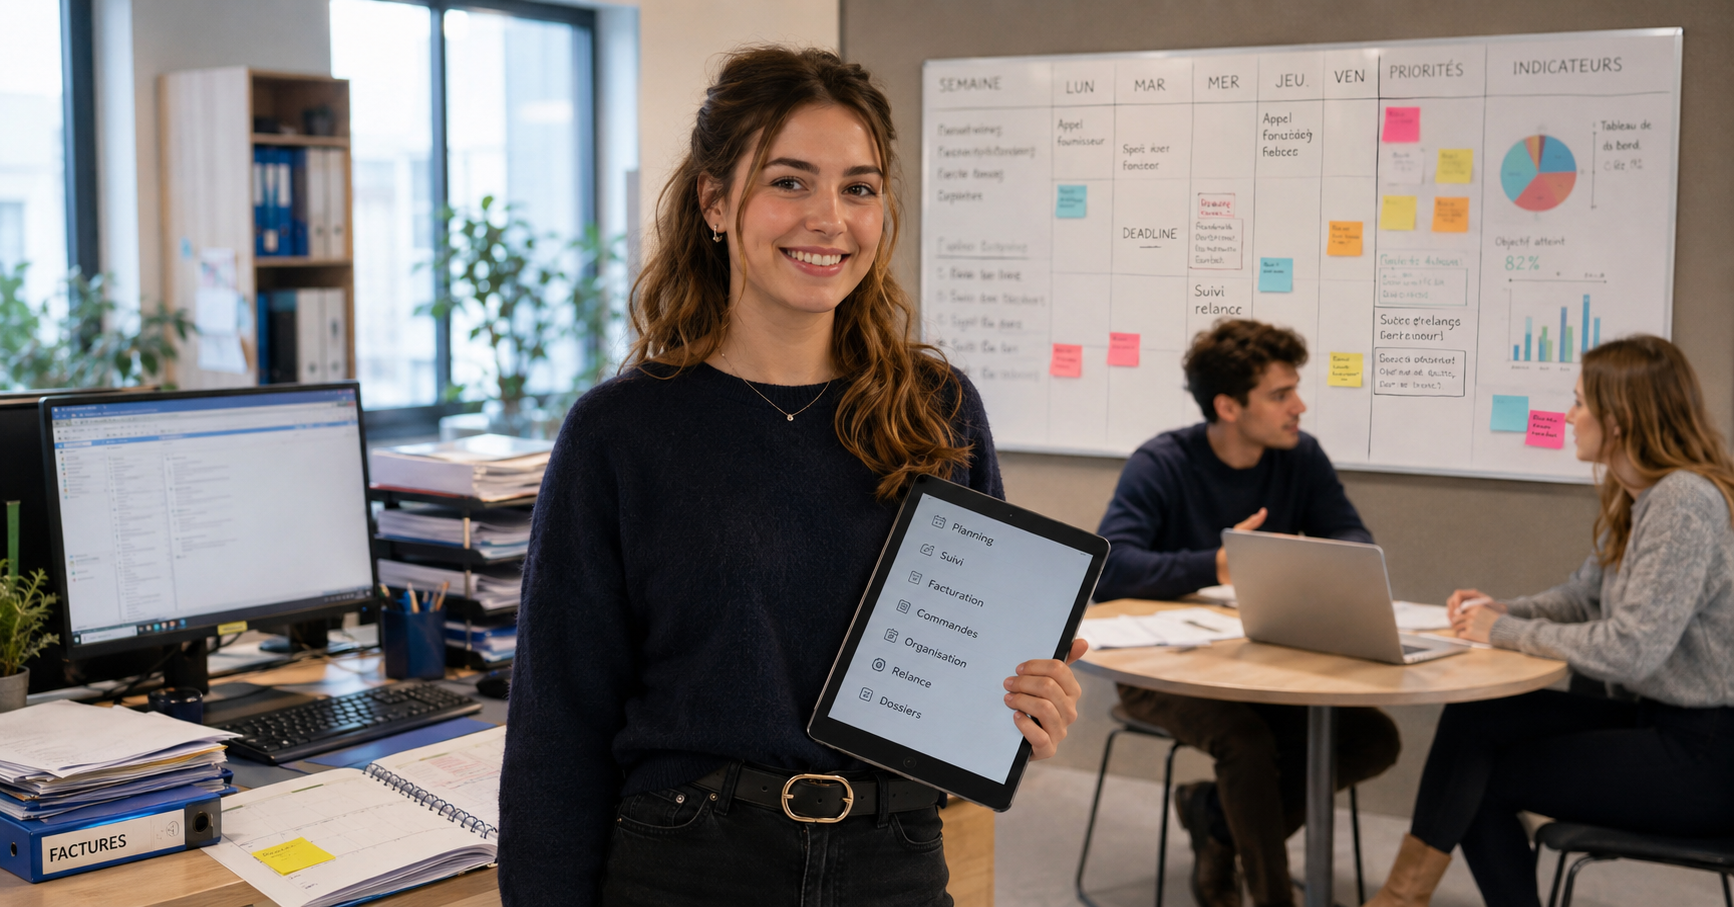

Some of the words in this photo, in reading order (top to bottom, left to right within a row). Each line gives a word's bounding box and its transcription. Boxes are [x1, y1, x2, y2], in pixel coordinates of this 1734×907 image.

[1389, 59, 1464, 80] PRIORITÉS
[1513, 56, 1623, 76] INDICATEURS
[939, 75, 1001, 93] SEMAINE
[1134, 77, 1166, 92] MAR
[1207, 74, 1240, 90] MER
[1334, 68, 1366, 84] VEN
[1065, 80, 1095, 95] LUN
[1057, 118, 1083, 133] Appel
[1262, 111, 1292, 127] Appel
[1600, 119, 1637, 131] Tableau
[1640, 118, 1652, 130] de
[1122, 226, 1178, 240] DEADLINE
[1494, 235, 1531, 251] Objectif
[1533, 236, 1566, 247] atteint
[1504, 254, 1541, 272] 82%
[1194, 283, 1225, 298] Suivi
[951, 522, 994, 547] Planning
[939, 551, 965, 567] Suivi
[927, 579, 984, 608] Facturation
[916, 608, 979, 639] Commandes
[904, 637, 967, 669] Organisation
[891, 666, 932, 689] Relance
[879, 695, 922, 720] Dossiers
[49, 833, 127, 863] FACTURES
